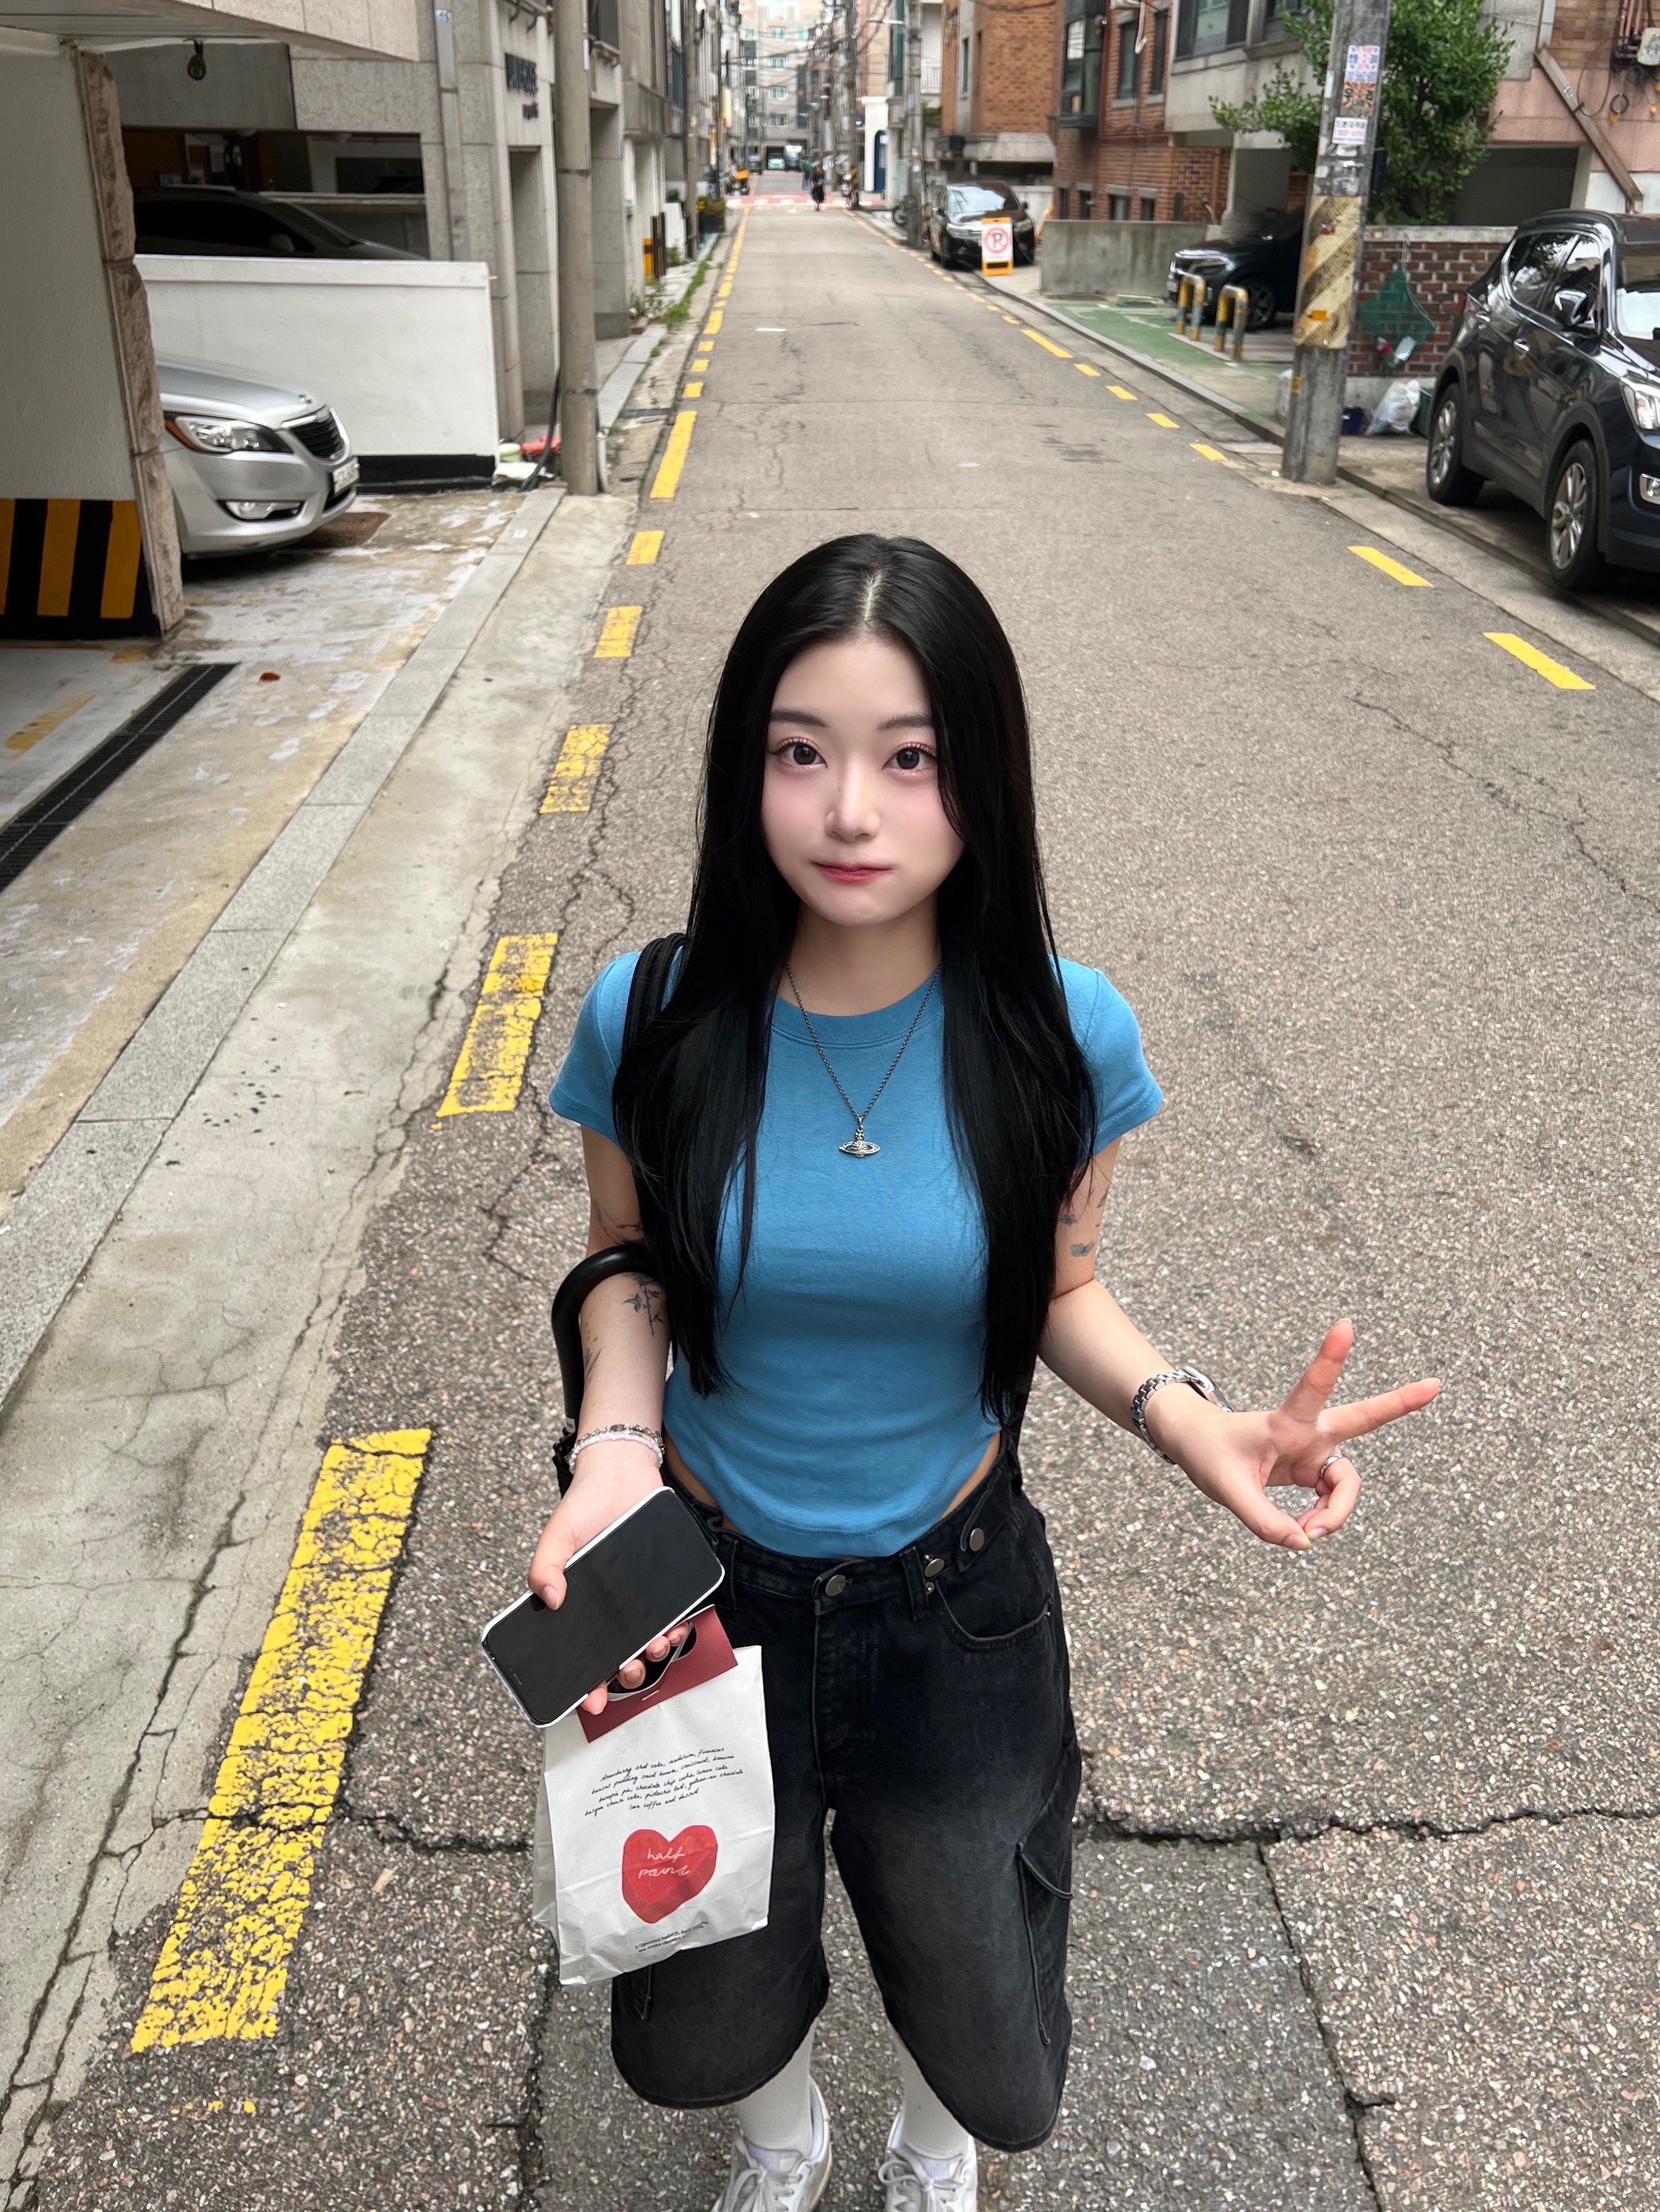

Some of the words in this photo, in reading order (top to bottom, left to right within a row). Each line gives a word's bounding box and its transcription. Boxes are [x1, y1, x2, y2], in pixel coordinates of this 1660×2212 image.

[635, 1782, 661, 1791] chocolate
[642, 1800, 662, 1810] coffee
[647, 1846, 686, 1863] half
